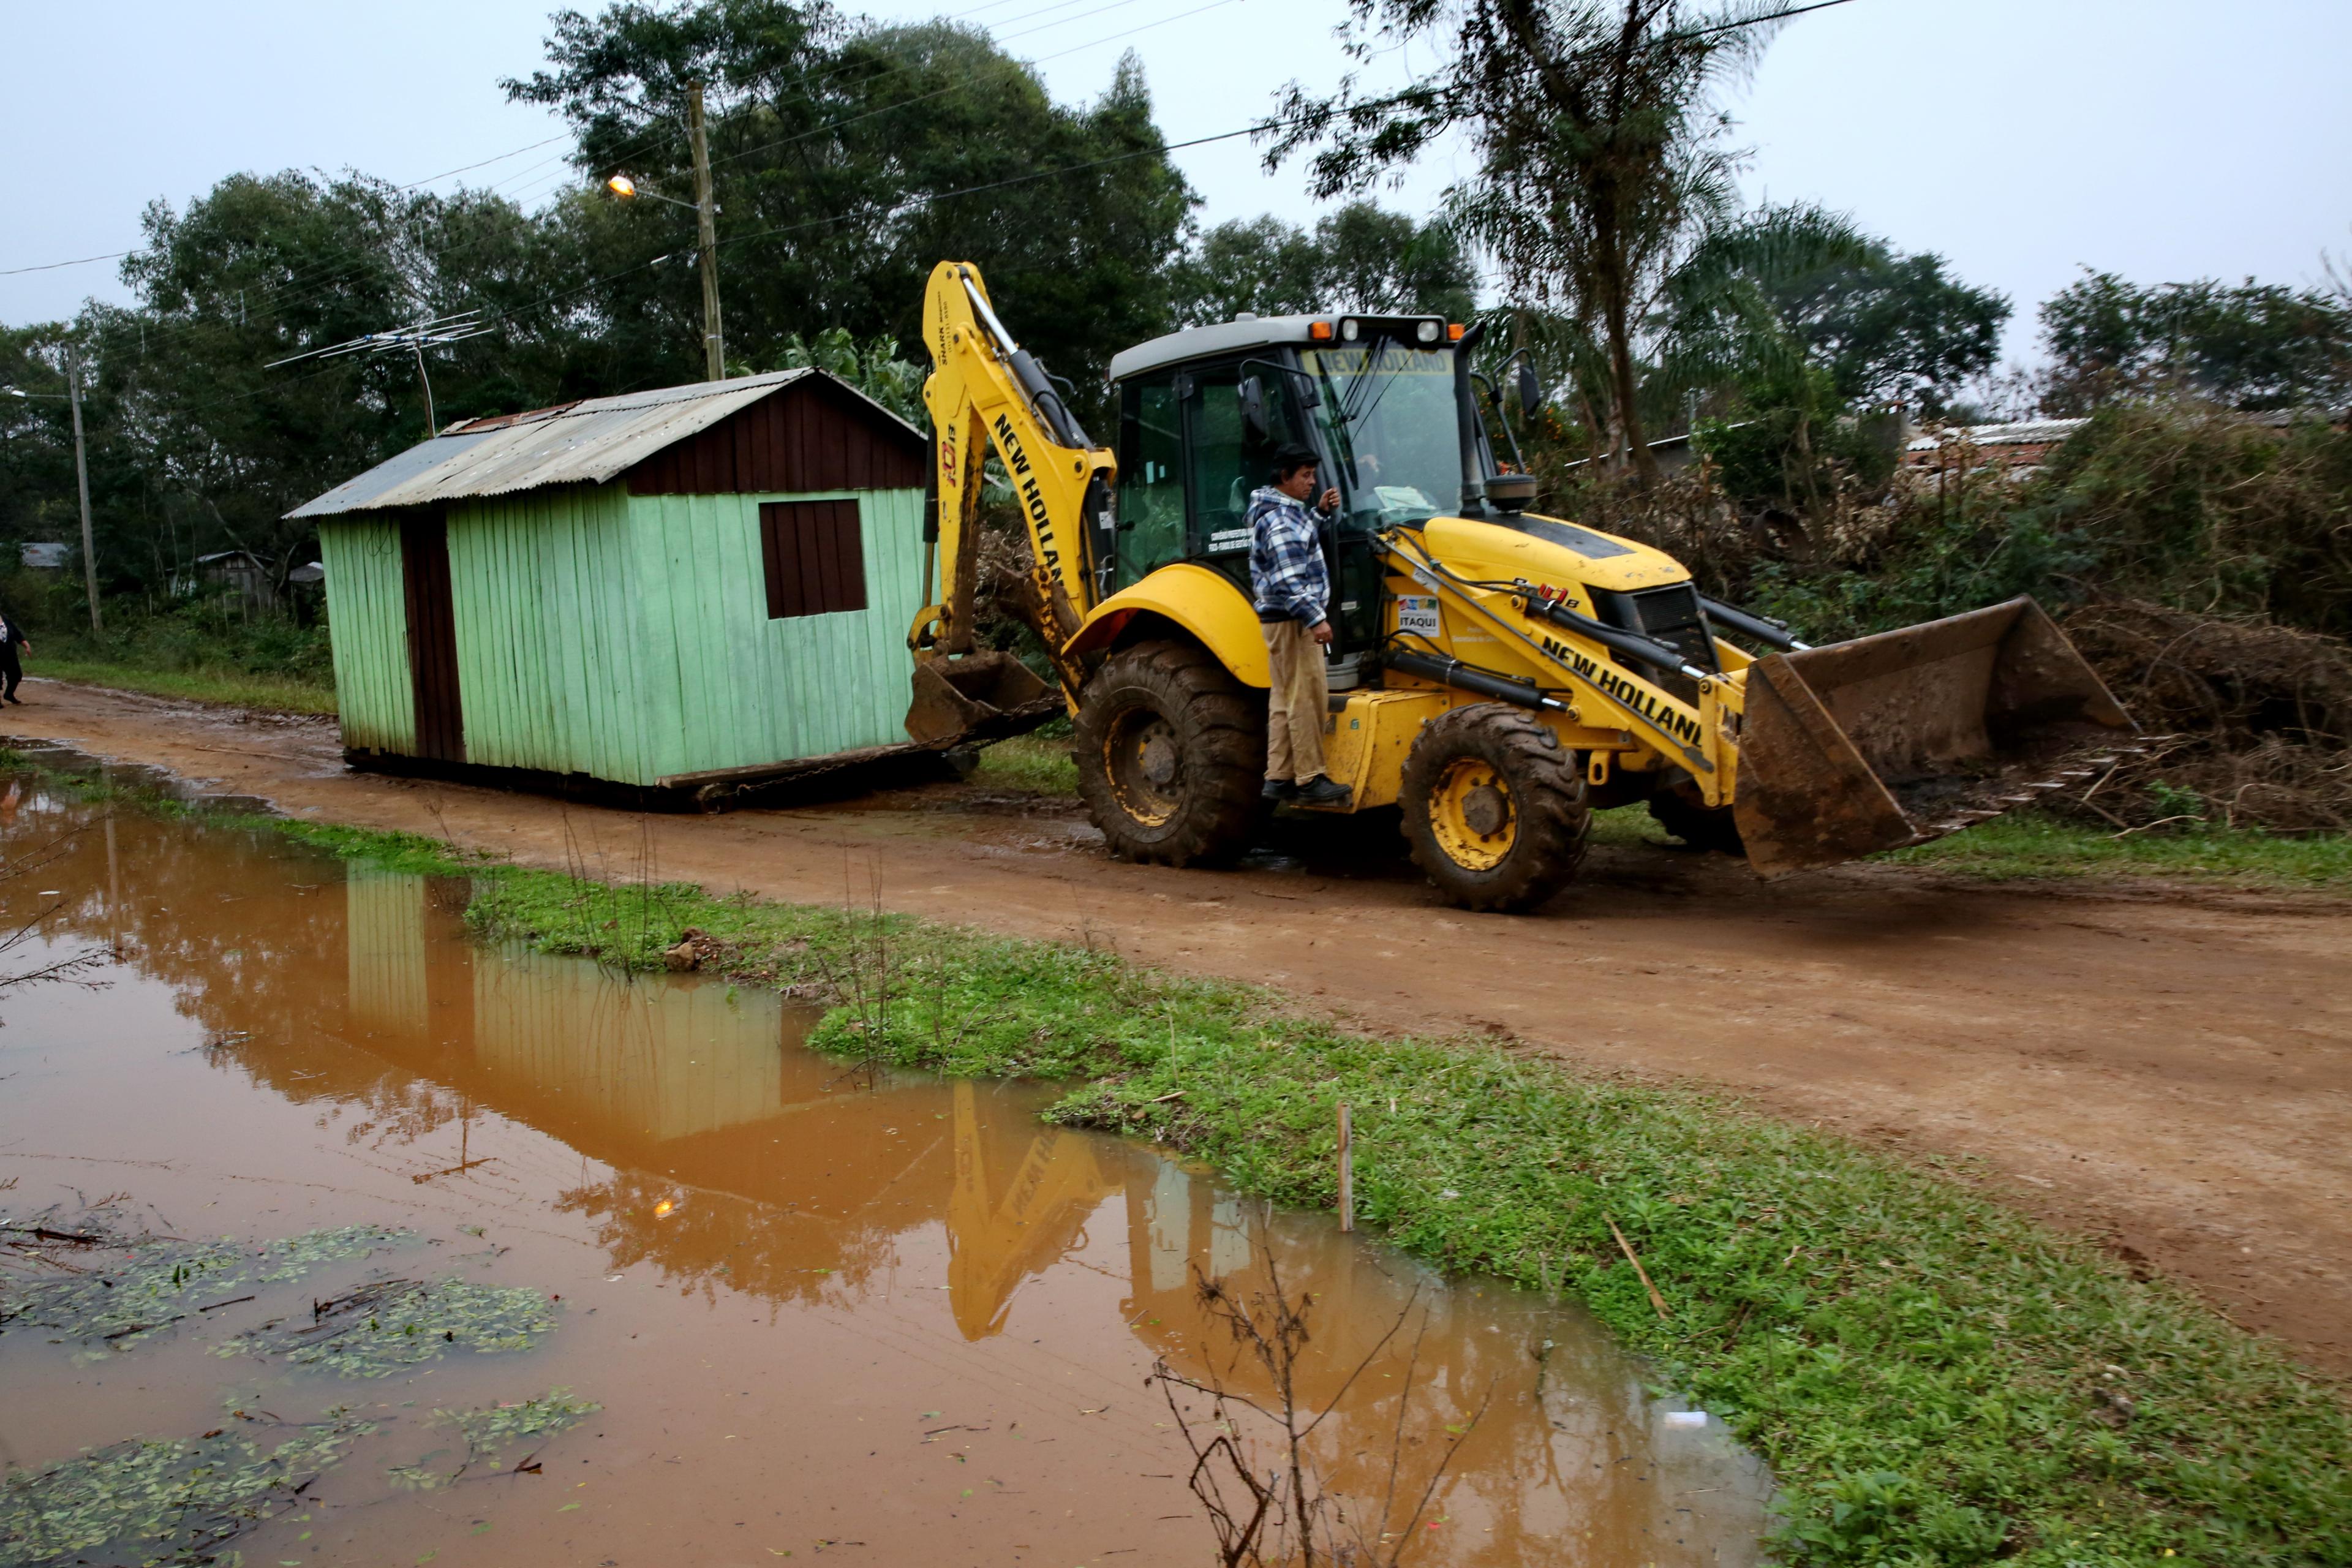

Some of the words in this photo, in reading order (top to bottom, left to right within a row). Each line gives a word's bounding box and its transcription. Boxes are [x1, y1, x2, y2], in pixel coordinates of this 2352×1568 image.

[938, 326, 948, 366] SHARK
[994, 413, 1031, 475] NEW
[1022, 477, 1064, 586] HOLLAN
[1400, 617, 1436, 628] ITAQUI
[1540, 636, 1597, 677] NEW
